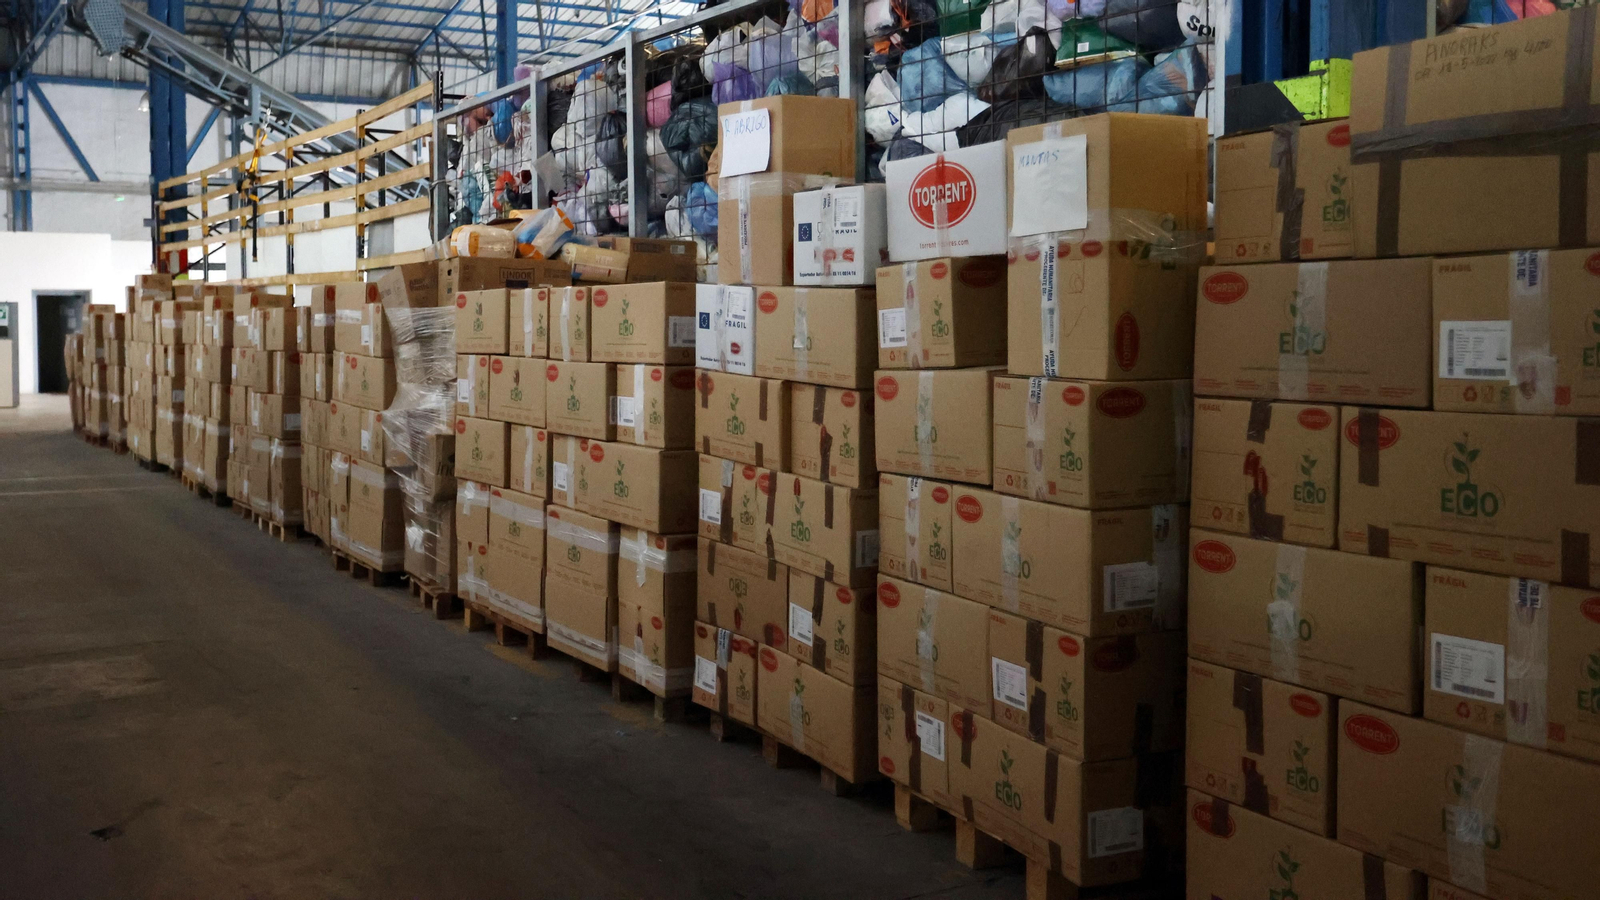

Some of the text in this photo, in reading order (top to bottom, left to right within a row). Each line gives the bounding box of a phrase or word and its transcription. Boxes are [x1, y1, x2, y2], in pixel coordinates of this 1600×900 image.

[1425, 31, 1500, 65] ANORAKS
[735, 115, 766, 135] ABRIGO
[915, 181, 967, 207] TORRENT
[502, 271, 532, 280] LINDOR
[1208, 283, 1244, 293] TORRENT
[725, 320, 747, 329] FRAGIL
[931, 322, 949, 337] ECO
[726, 417, 745, 435] ECO
[1351, 426, 1394, 438] TONT
[839, 444, 854, 458] ECO
[1060, 453, 1082, 471] ECO
[1293, 483, 1326, 504] ECO
[1440, 485, 1499, 517] ECO
[958, 503, 982, 513] TORRENT
[791, 521, 810, 541] ECO
[929, 544, 946, 560] ECO
[1197, 549, 1232, 562] TORRENT
[834, 639, 850, 655] ECO
[1057, 700, 1078, 721] ECO
[1349, 724, 1393, 743] TORRENT
[1287, 769, 1318, 792] ECO
[995, 780, 1021, 811] ECO
